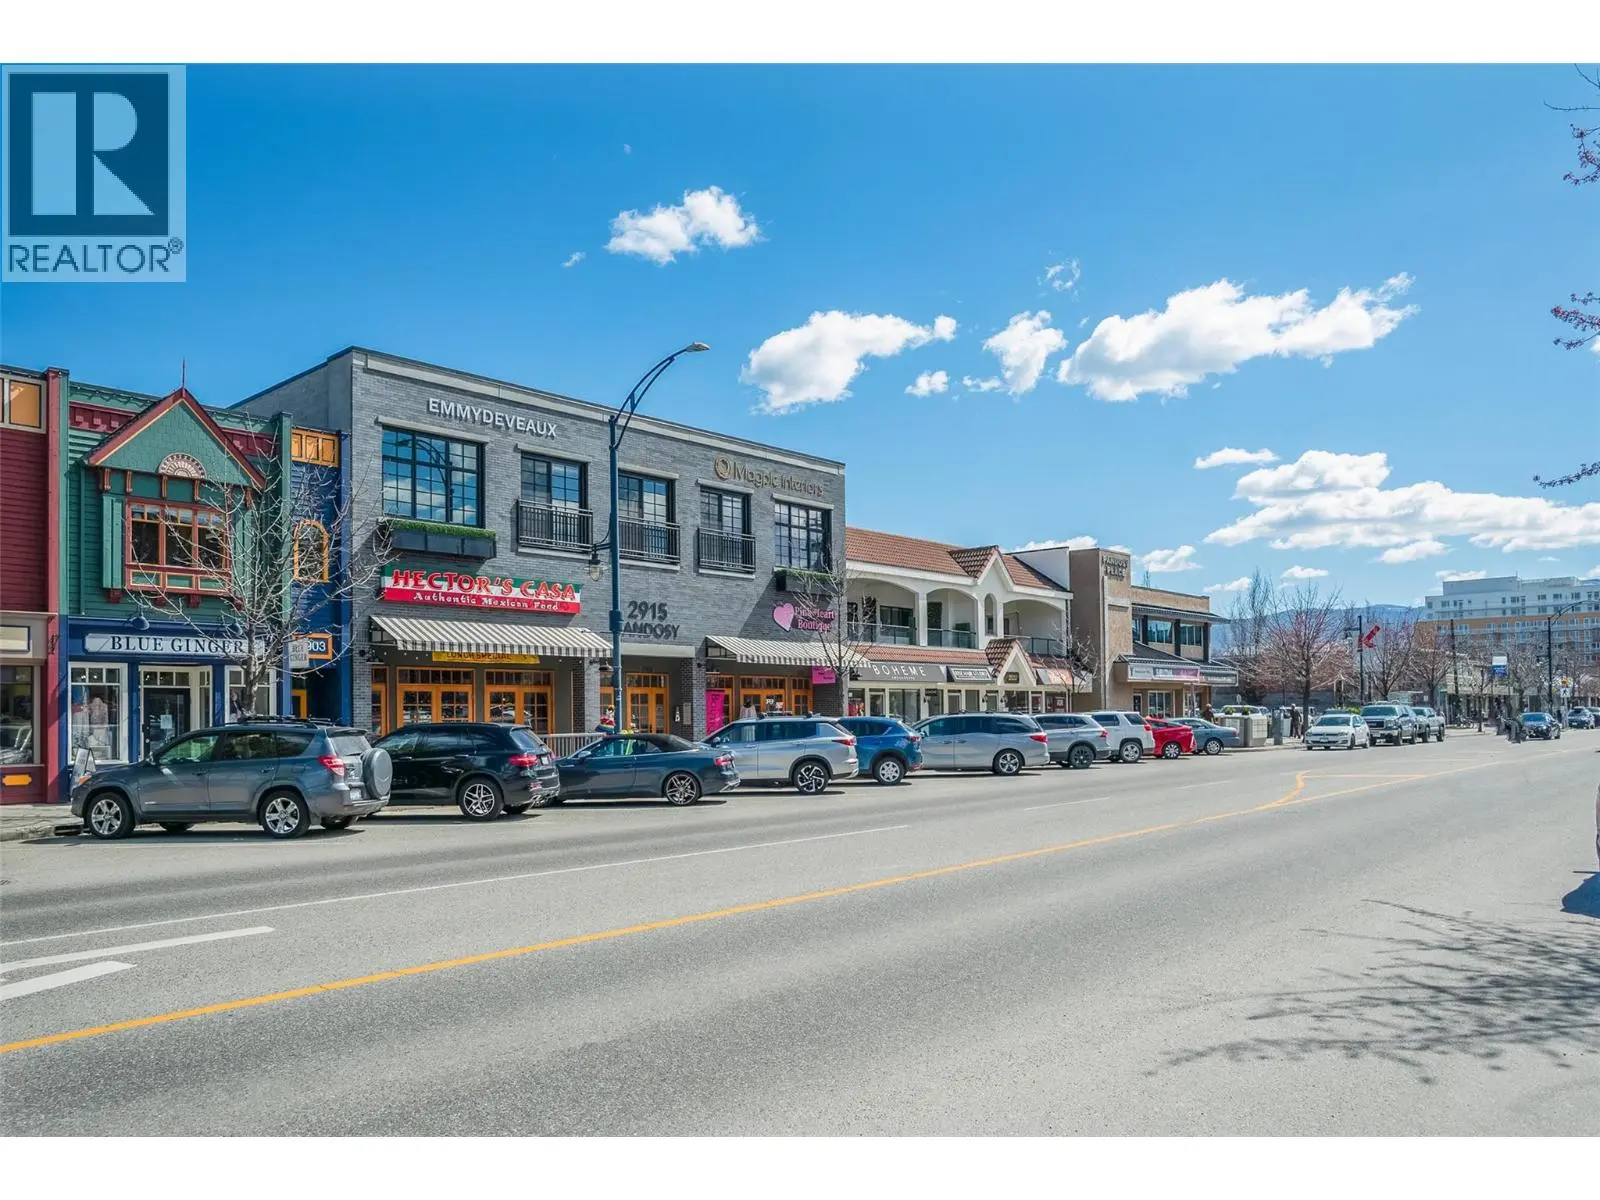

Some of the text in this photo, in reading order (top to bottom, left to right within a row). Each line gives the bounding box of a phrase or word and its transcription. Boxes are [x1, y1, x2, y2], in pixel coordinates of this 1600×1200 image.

[428, 397, 557, 438] EMMYDEVEAUX
[733, 461, 778, 488] Magpie
[392, 569, 577, 600] HECTOR'S CASA
[413, 591, 559, 611] Authentic Mexican Food
[627, 600, 668, 622] 2915
[623, 621, 680, 640] ANDOSY
[111, 636, 244, 654] BLUE GINGER
[872, 664, 927, 677] BOHEME
